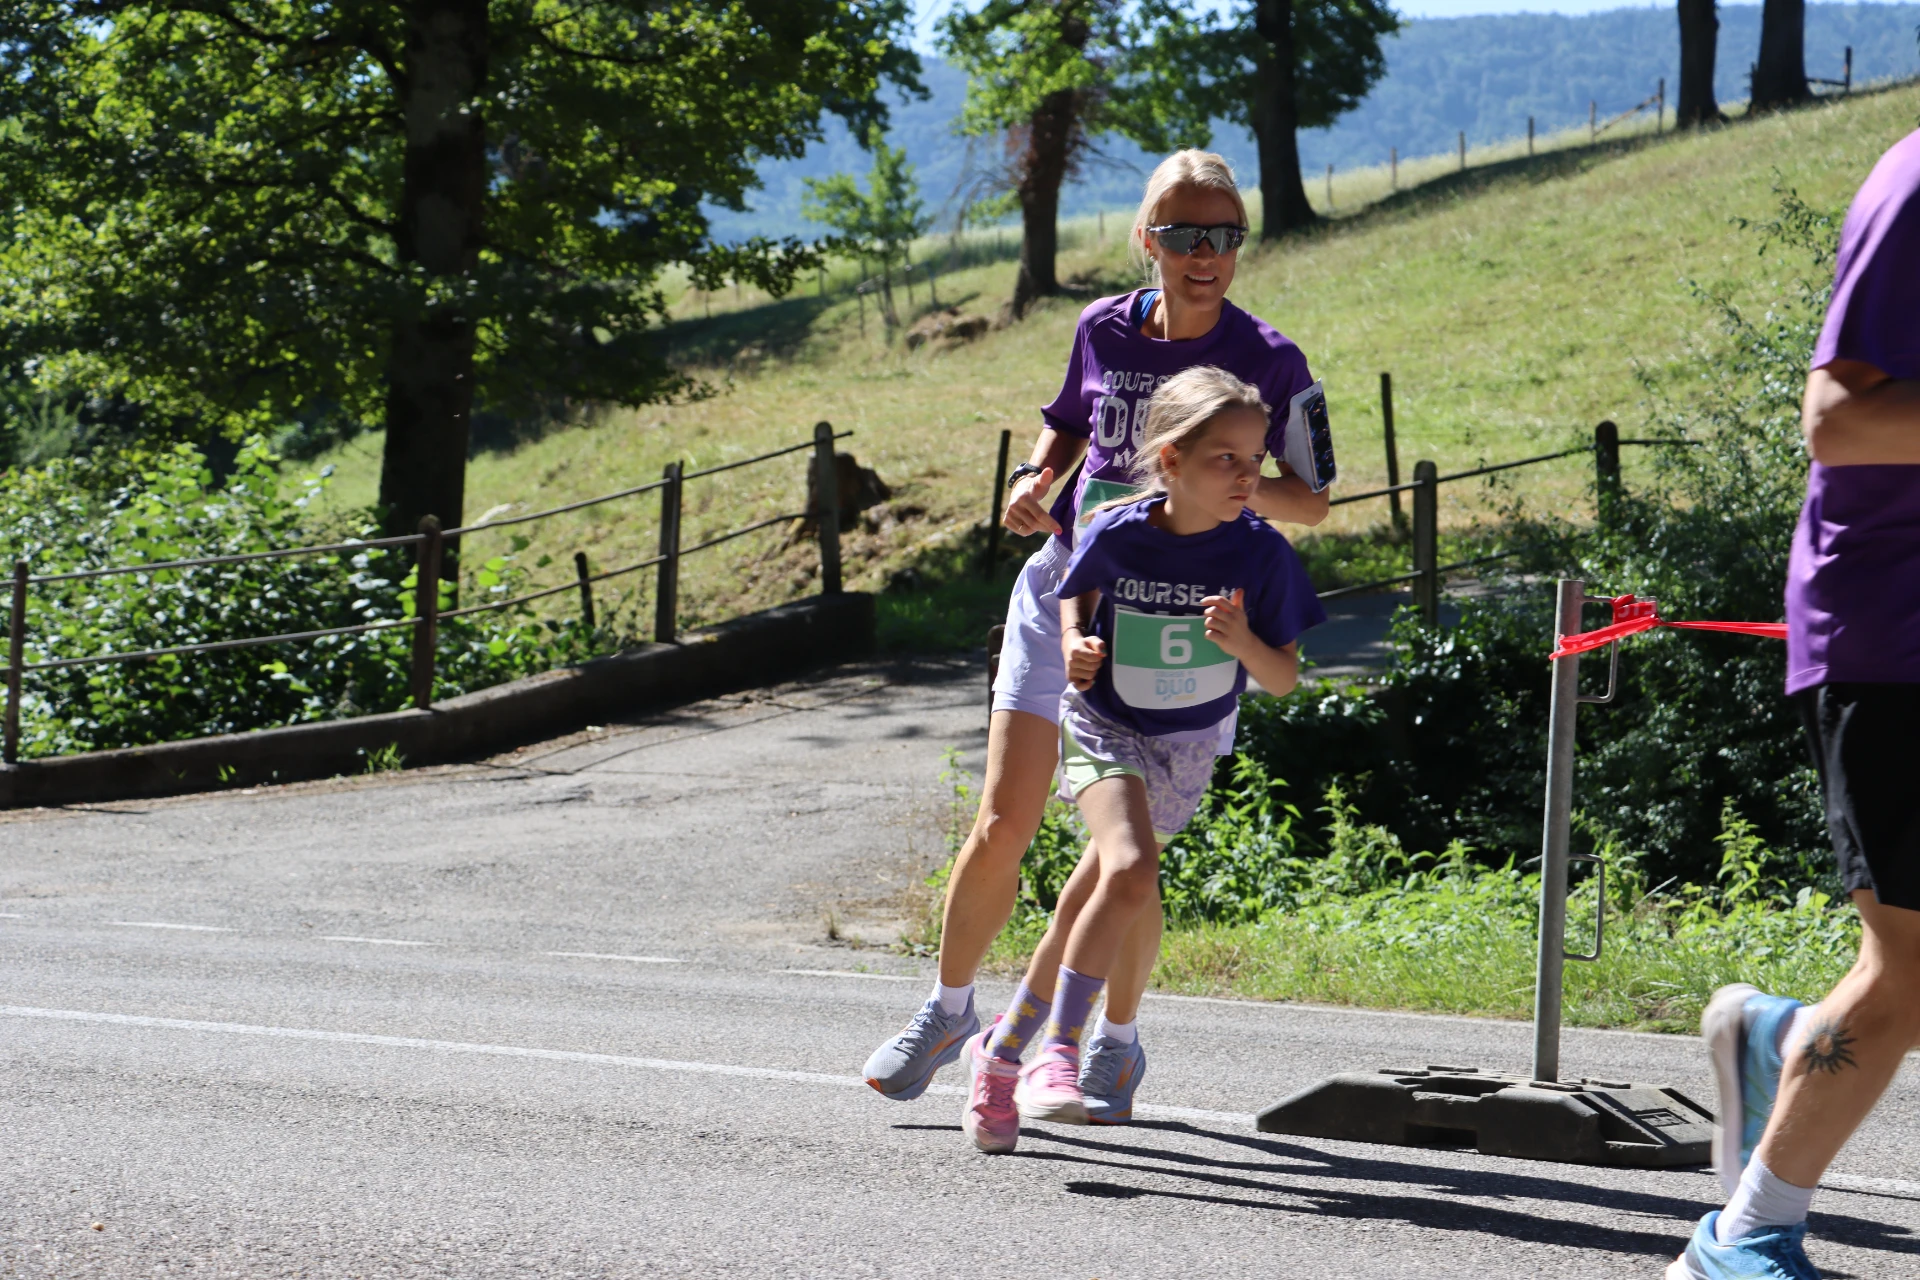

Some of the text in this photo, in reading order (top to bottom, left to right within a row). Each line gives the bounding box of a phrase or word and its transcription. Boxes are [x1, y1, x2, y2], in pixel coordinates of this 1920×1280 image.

[1102, 371, 1174, 393] COUR
[1114, 577, 1206, 606] COURSE
[1160, 624, 1193, 664] 6
[1155, 677, 1197, 695] DUO
